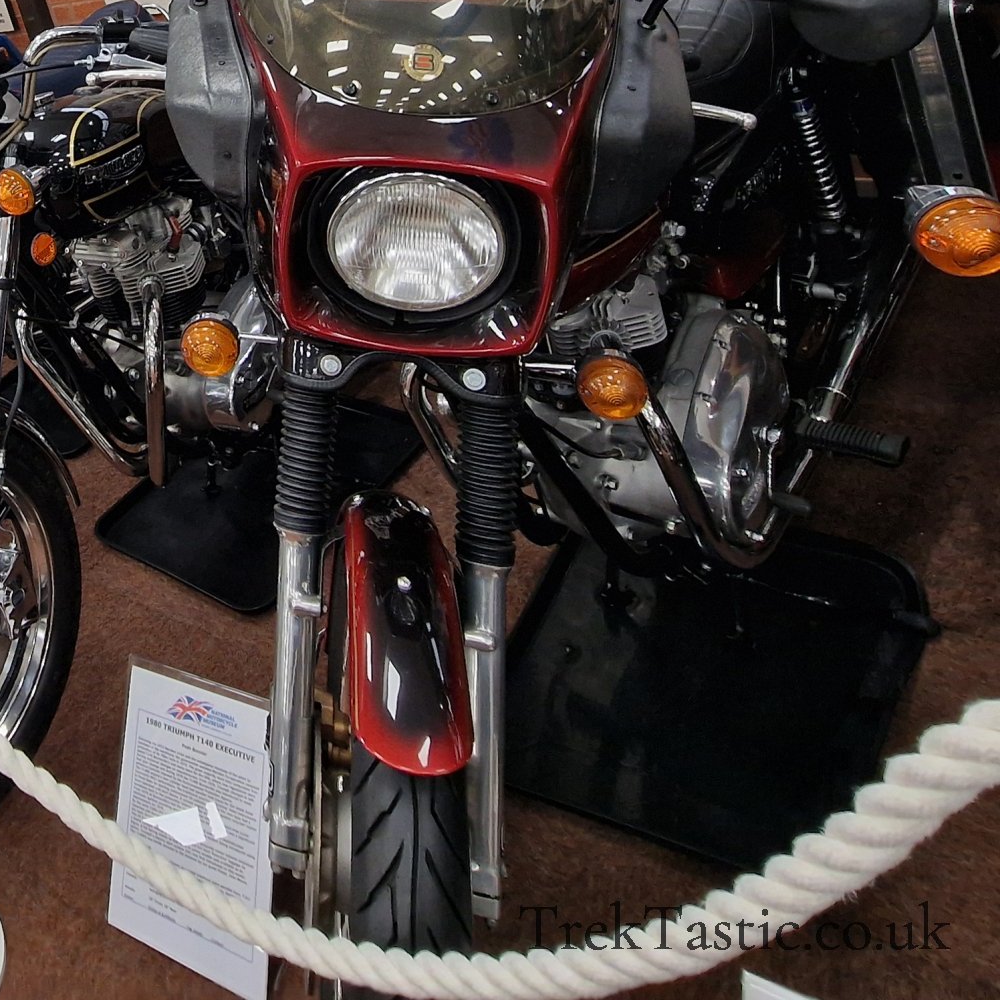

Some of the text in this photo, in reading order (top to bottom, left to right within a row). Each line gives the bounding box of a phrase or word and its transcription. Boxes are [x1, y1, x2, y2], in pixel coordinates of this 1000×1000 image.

[146, 717, 162, 729] 1980
[164, 723, 195, 741] TRIUMPH
[197, 735, 214, 748] T140
[215, 743, 256, 763] EXECUTIVE
